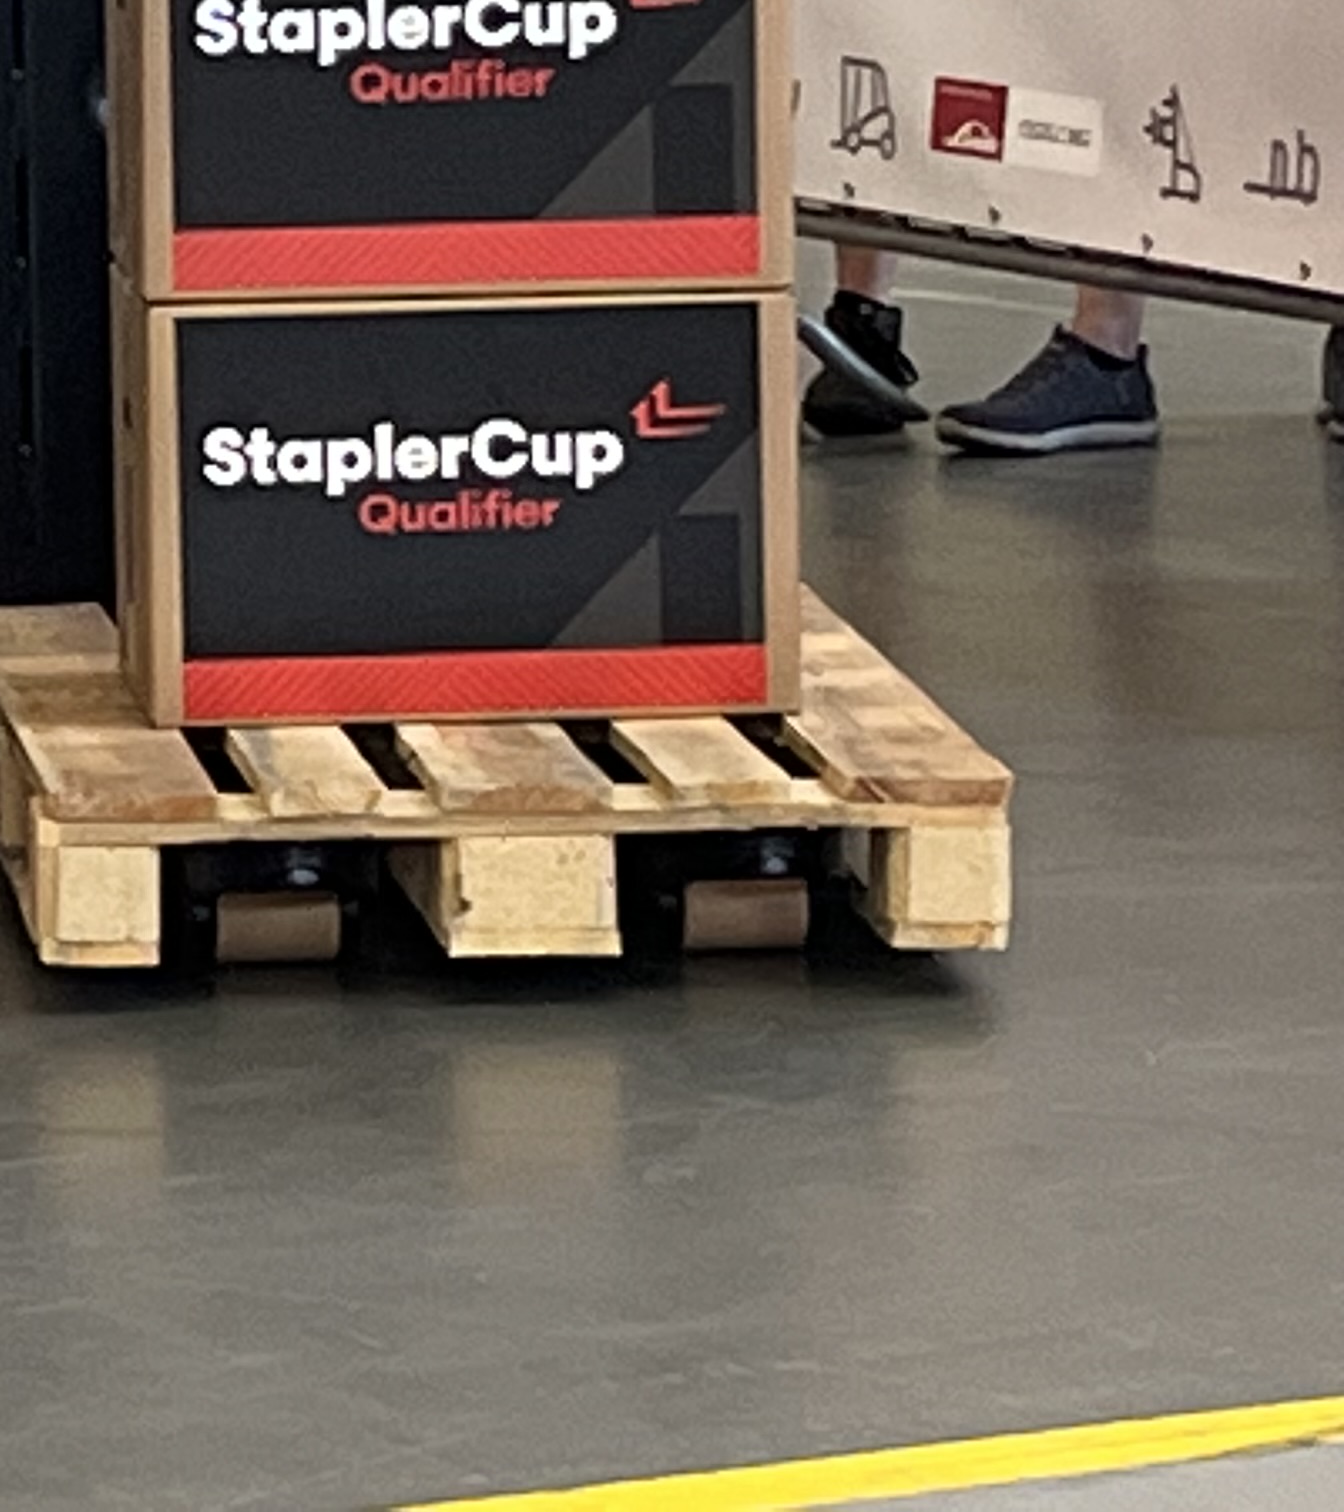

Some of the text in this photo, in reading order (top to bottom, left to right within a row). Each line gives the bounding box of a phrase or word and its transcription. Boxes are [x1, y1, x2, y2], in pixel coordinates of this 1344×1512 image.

[350, 58, 555, 106] Qualifier
[202, 418, 624, 497] StaplerCup
[358, 489, 560, 535] Qualifier
